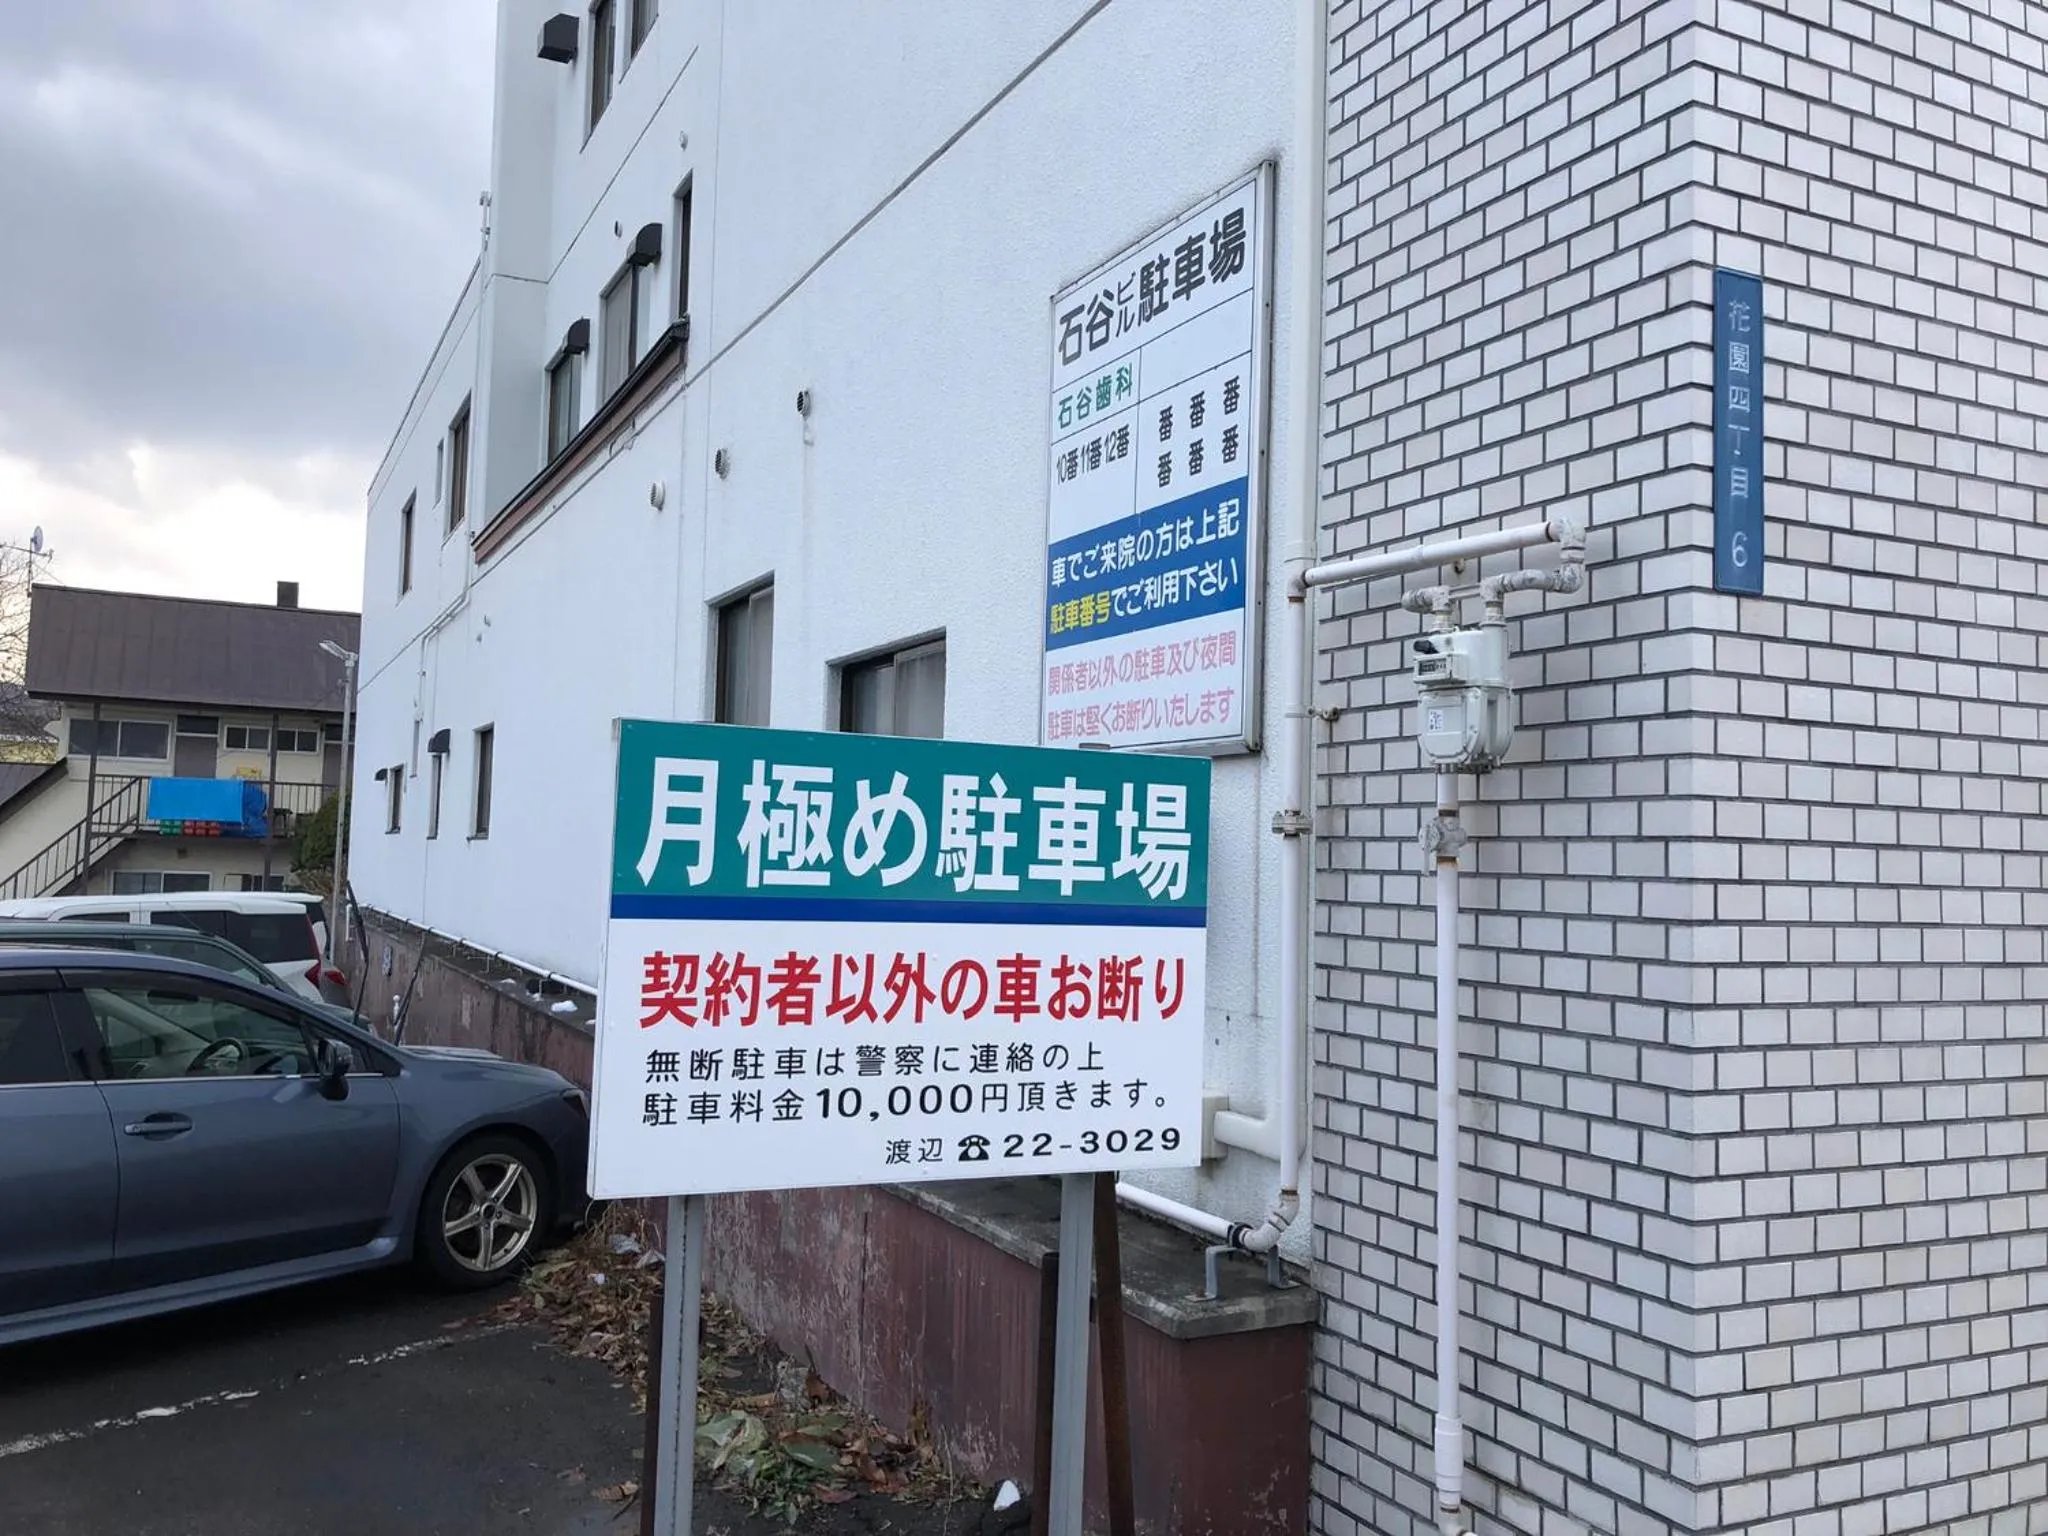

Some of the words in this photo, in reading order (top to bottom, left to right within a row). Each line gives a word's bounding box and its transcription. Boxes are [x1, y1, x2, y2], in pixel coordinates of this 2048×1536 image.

[1058, 207, 1246, 366] 石谷ビル駐車場
[1158, 405, 1173, 442] 番
[1190, 391, 1205, 429] 番
[1223, 375, 1240, 416] 番
[1157, 451, 1172, 488] 番
[1189, 438, 1204, 476] 番
[1222, 424, 1239, 464] 番
[1051, 498, 1240, 588] 車でご来院の方は上記
[1732, 531, 1748, 568] 6
[1051, 557, 1238, 634] 駐車番号でご利用下さい
[1048, 630, 1237, 696] 関係者以外の駐車及び夜間
[1047, 688, 1234, 740] 駐車は堅くお断りいたします
[636, 756, 1192, 901] 月極め駐車場
[639, 950, 1186, 1029] 契約者以外の車お断り
[645, 1041, 1104, 1083] 無断駐車は警察に連絡の上
[642, 1077, 1168, 1126] 駐車料金10,000円頂きます。
[885, 1138, 944, 1165] 渡辺
[1003, 1127, 1182, 1158] 22-3029
